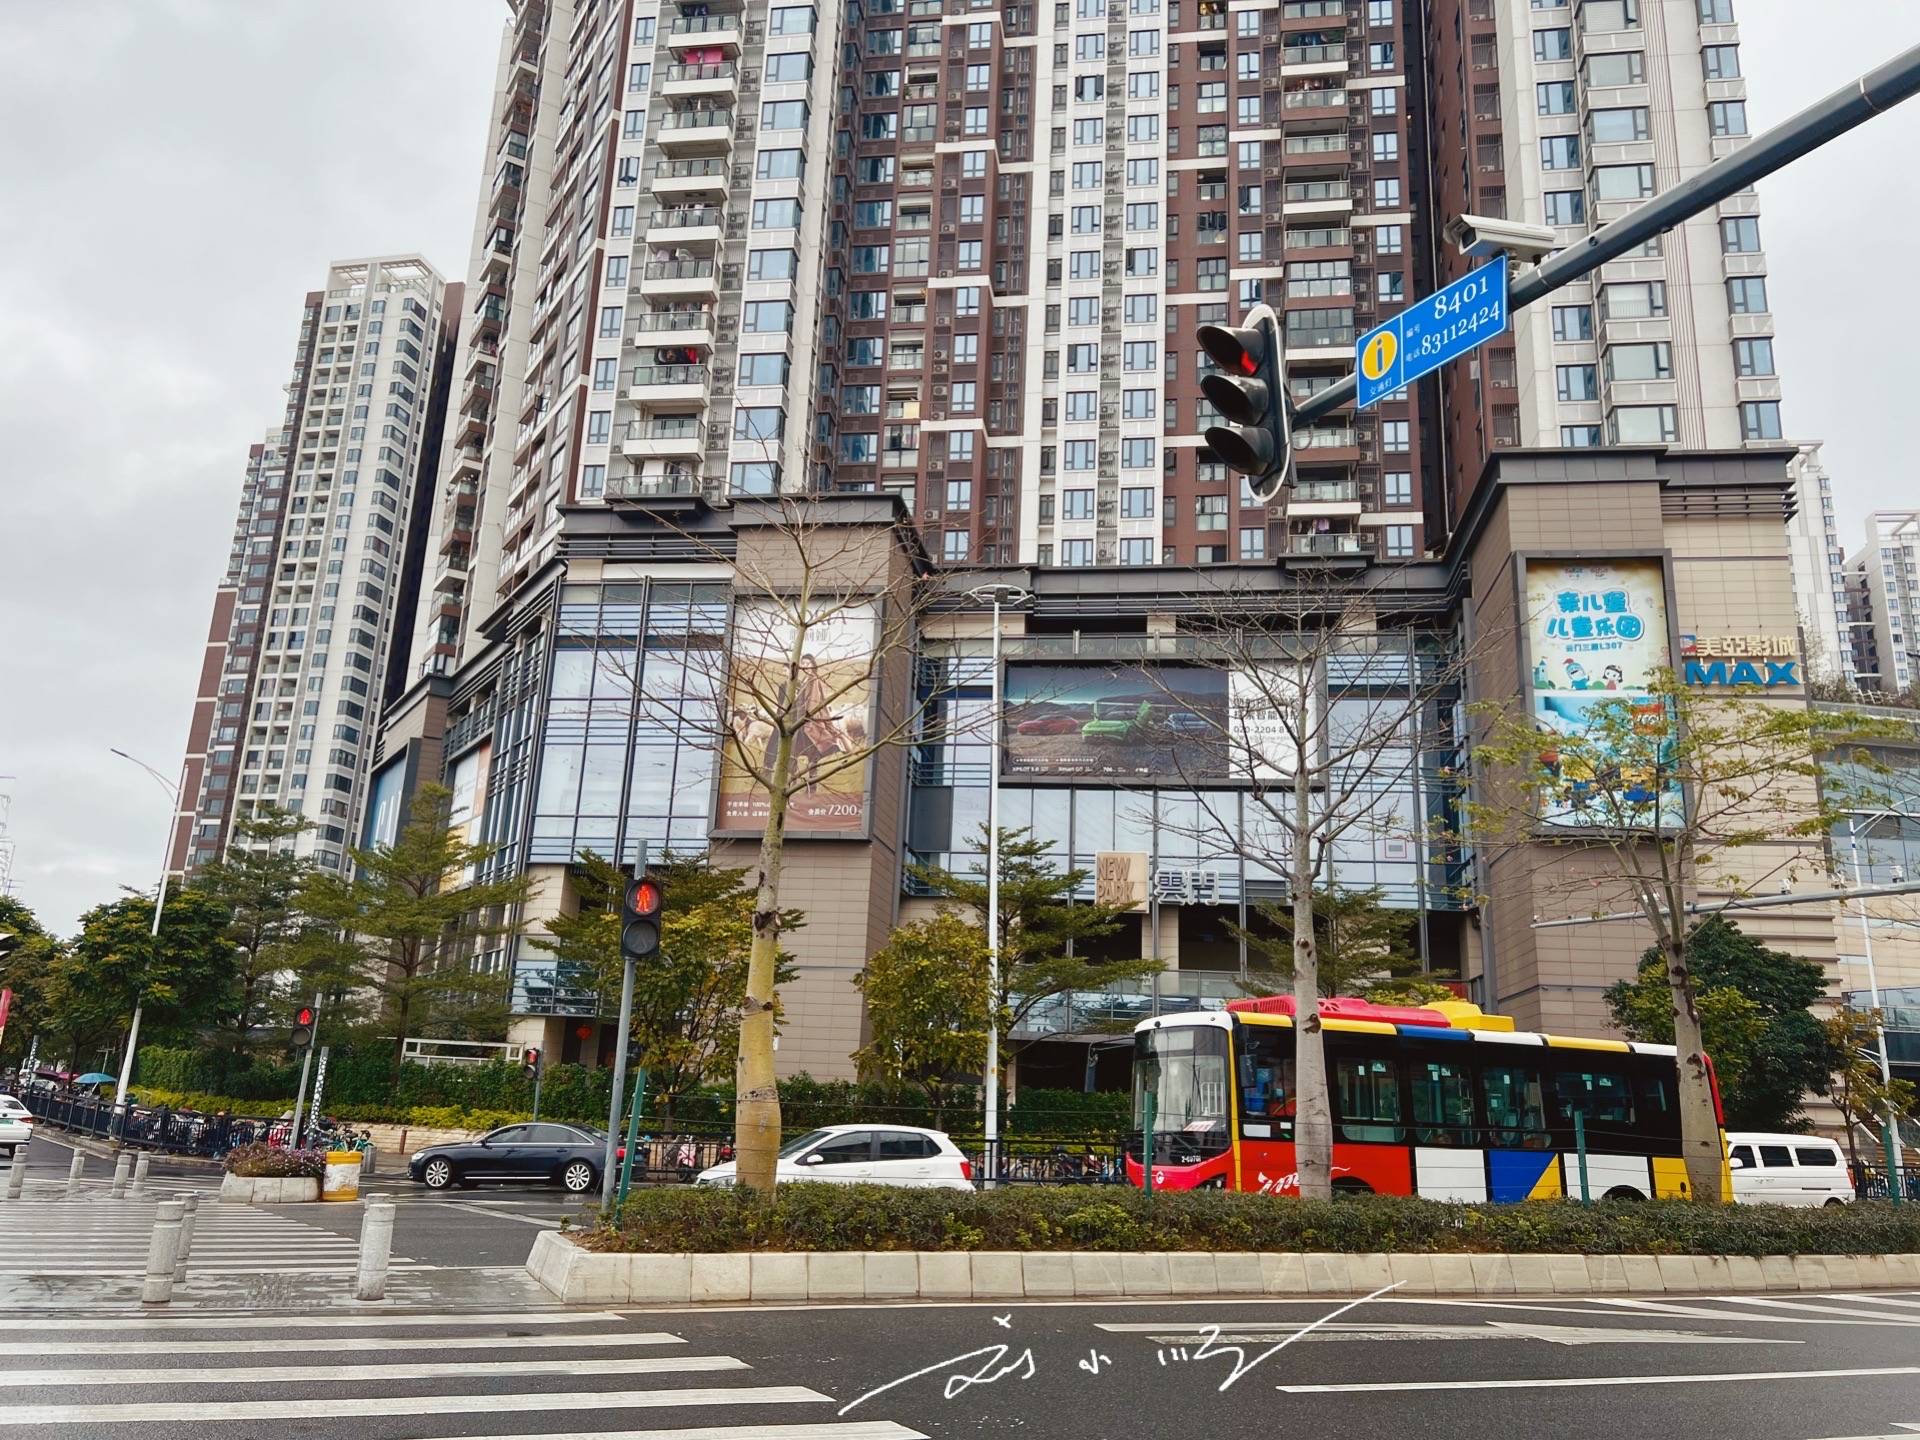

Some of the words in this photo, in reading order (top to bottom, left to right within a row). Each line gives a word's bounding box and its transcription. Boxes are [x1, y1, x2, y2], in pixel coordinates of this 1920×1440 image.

[1434, 275, 1489, 320] 8401
[1421, 300, 1500, 355] 83112424
[1546, 614, 1642, 639] 儿童乐园
[1696, 634, 1795, 657] 美亞影城
[828, 804, 857, 816] 7200
[1099, 857, 1131, 881] NEW
[1098, 881, 1134, 904] PARK
[1154, 869, 1219, 906] 雲門
